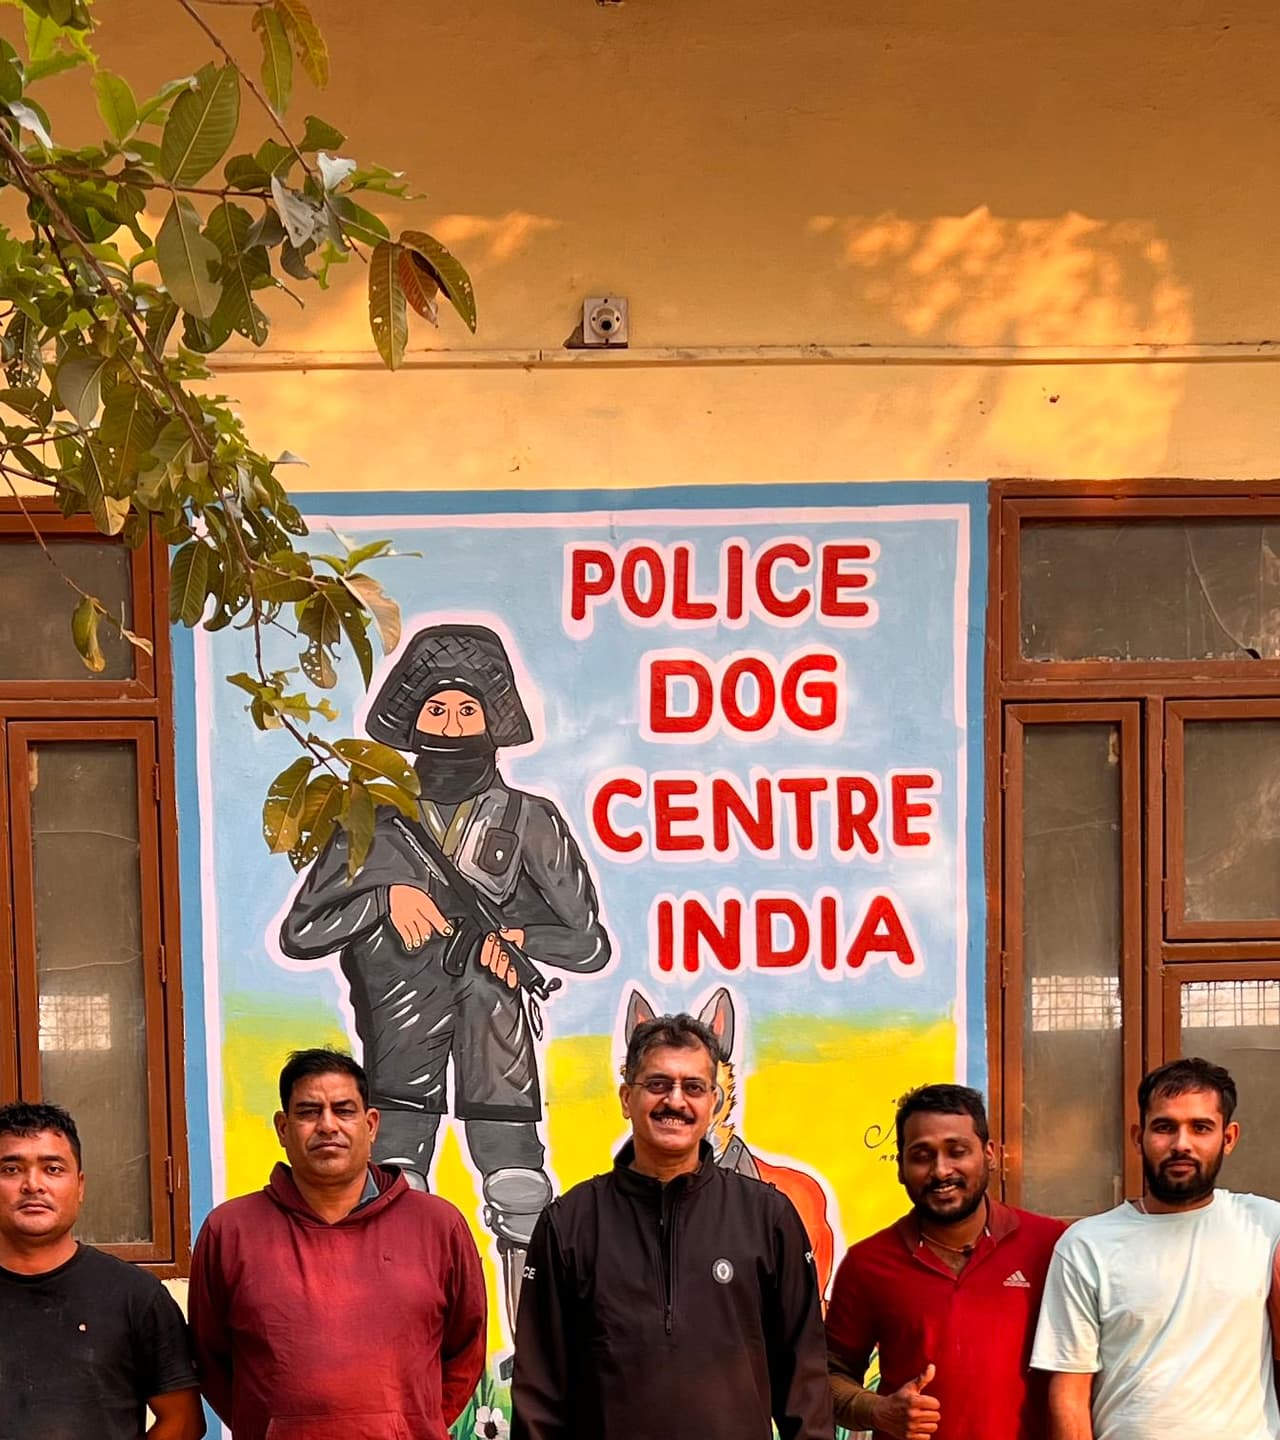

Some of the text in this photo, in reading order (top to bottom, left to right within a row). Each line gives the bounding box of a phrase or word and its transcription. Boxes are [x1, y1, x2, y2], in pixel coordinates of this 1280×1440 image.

[570, 543, 872, 621] POLICE
[649, 654, 838, 734] DOG
[591, 774, 934, 855] CENTRE
[657, 895, 915, 973] INDIA
